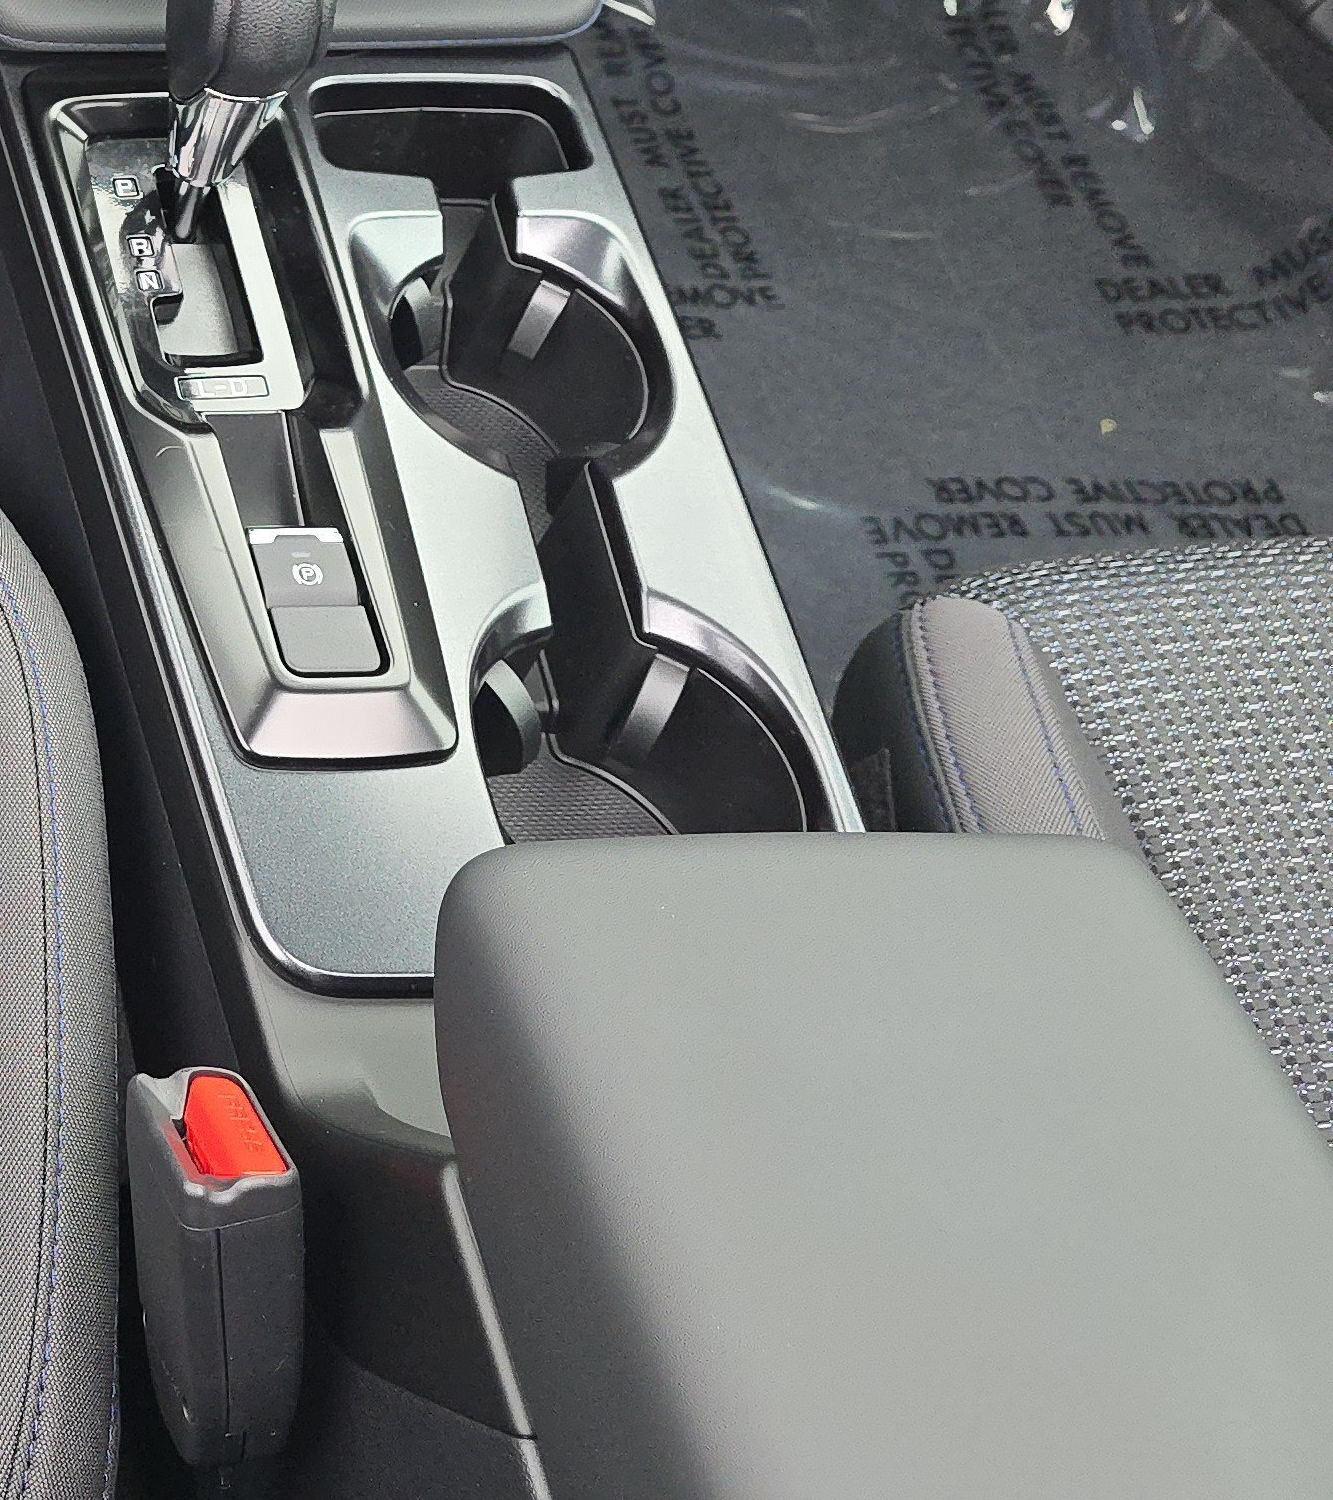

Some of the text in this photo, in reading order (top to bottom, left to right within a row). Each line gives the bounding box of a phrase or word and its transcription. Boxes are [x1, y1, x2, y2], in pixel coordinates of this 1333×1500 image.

[117, 179, 138, 196] P
[132, 240, 152, 254] R
[140, 273, 159, 289] N
